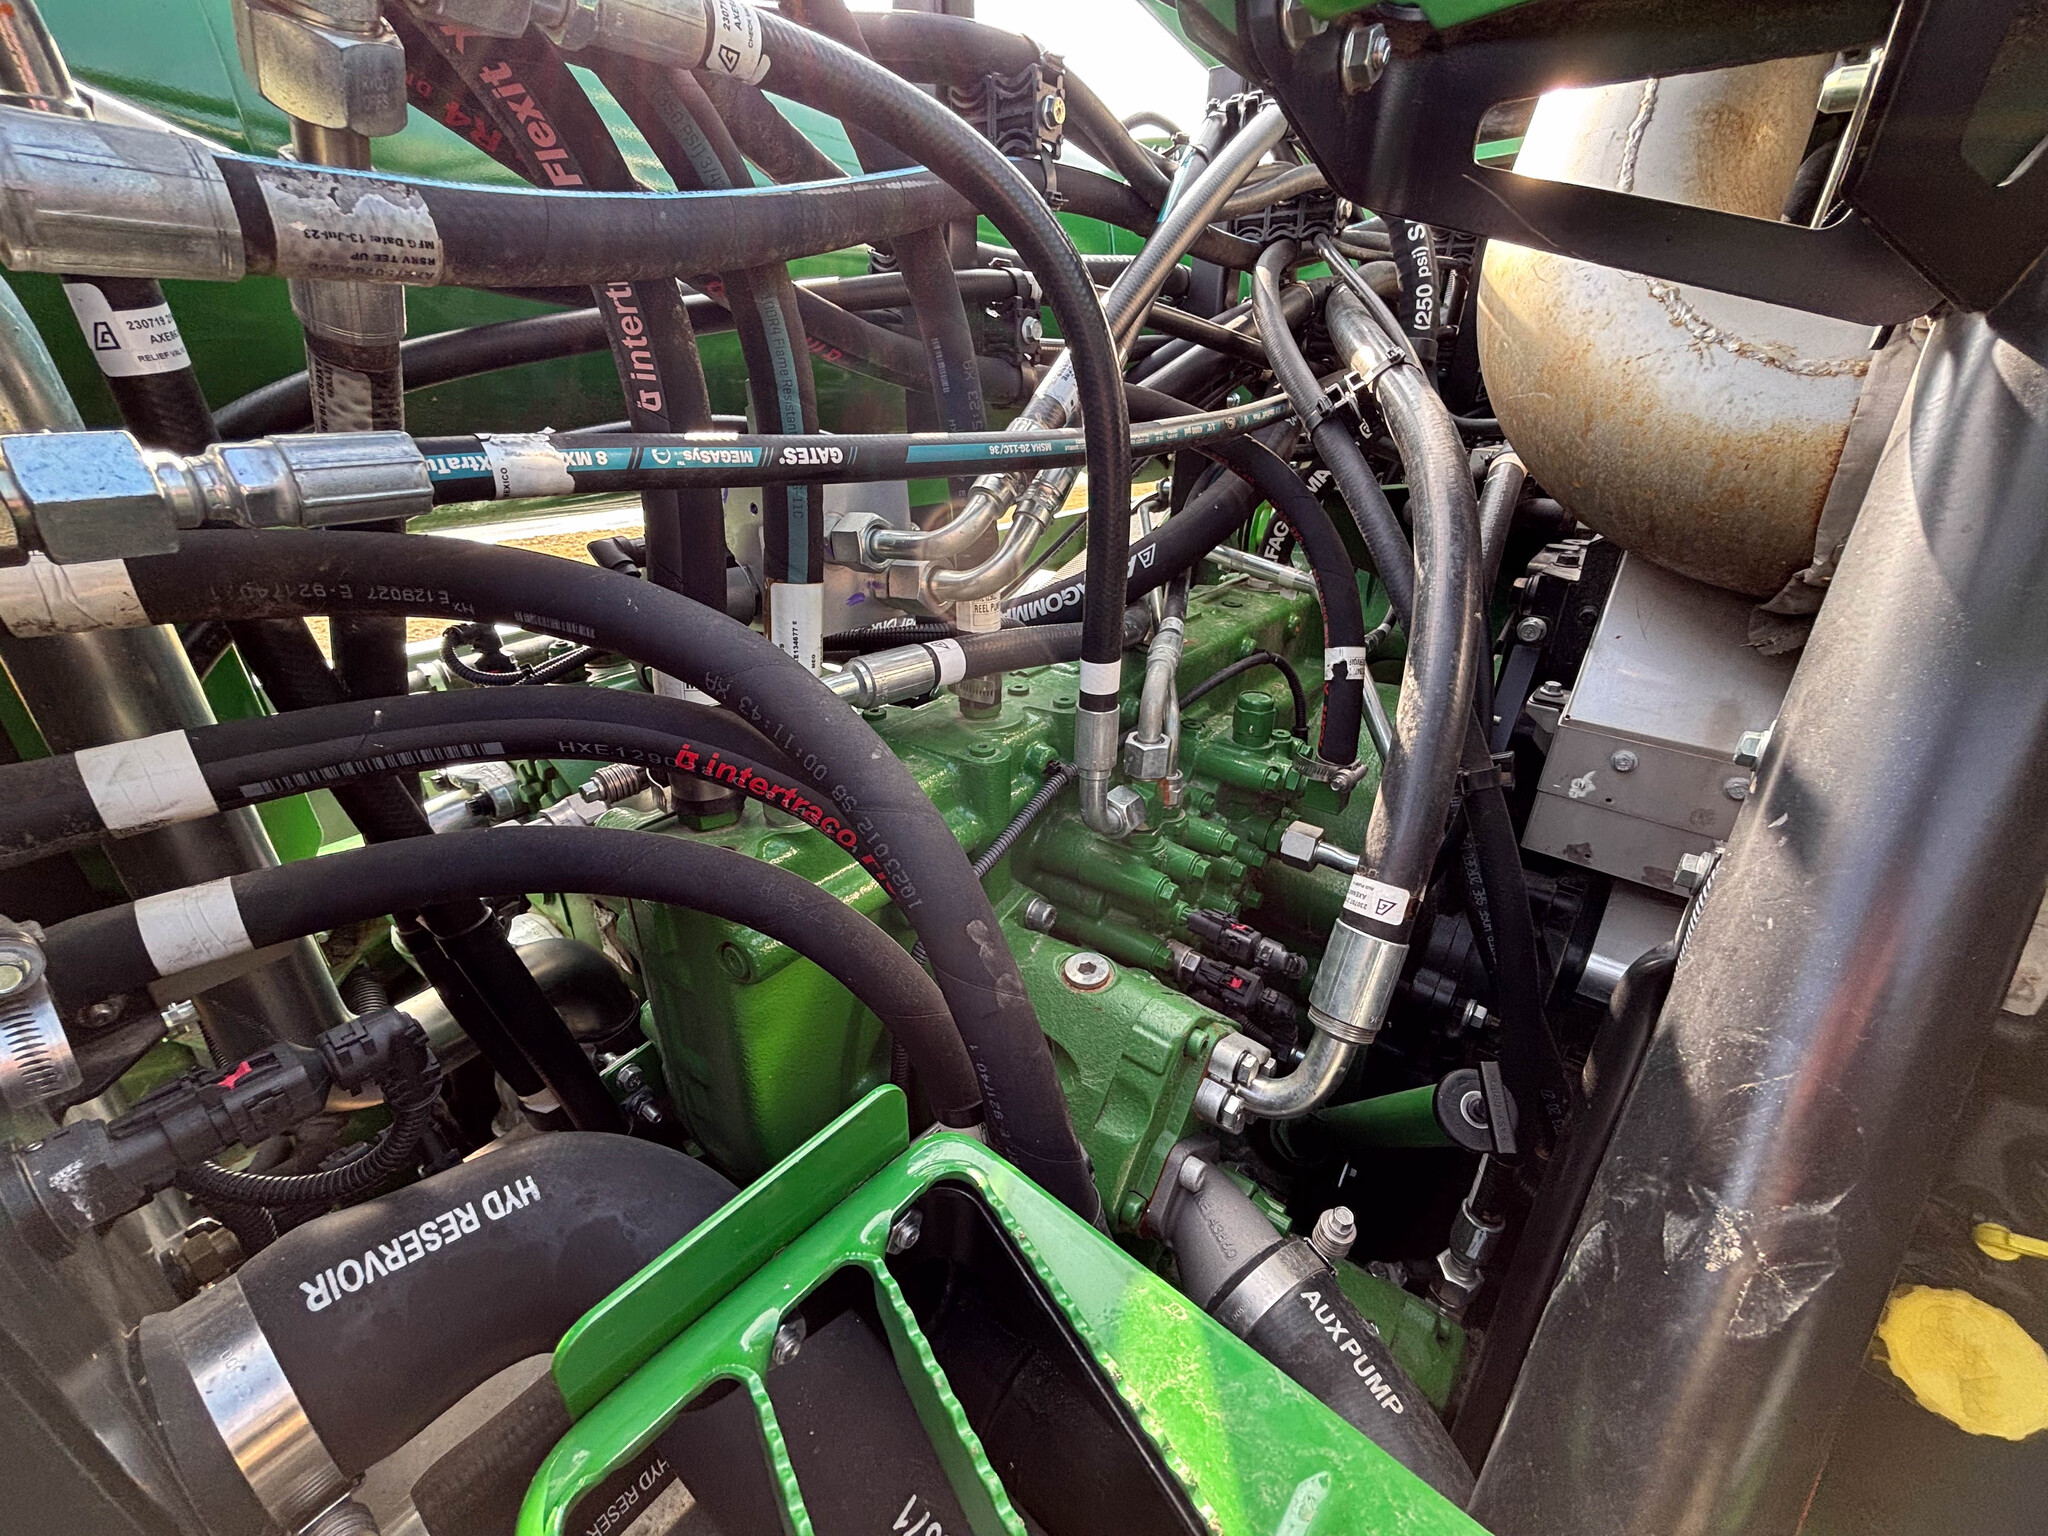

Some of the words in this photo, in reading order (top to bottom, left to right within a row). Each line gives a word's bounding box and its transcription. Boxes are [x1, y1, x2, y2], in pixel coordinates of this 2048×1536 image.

[479, 61, 583, 187] Flexit
[370, 234, 404, 247] Date:
[406, 238, 435, 250] MFG
[350, 252, 369, 262] UP
[373, 253, 399, 264] TEE
[401, 255, 436, 266] RSRV
[1410, 245, 1433, 278] psi)
[1412, 283, 1434, 331] (250
[126, 316, 165, 331] 230719
[137, 350, 171, 363] RELIEF
[772, 338, 790, 377] Flame
[683, 447, 754, 464] MEGASys
[784, 446, 844, 465] GATES
[1030, 442, 1053, 454] MSHA
[597, 449, 609, 466] 8
[973, 603, 990, 614] REEL
[480, 1175, 542, 1221] HYD
[298, 1202, 482, 1313] RESERVOIR
[1300, 1290, 1350, 1342] AUX
[1339, 1337, 1404, 1414] PUMP
[637, 1457, 672, 1492] HYD
